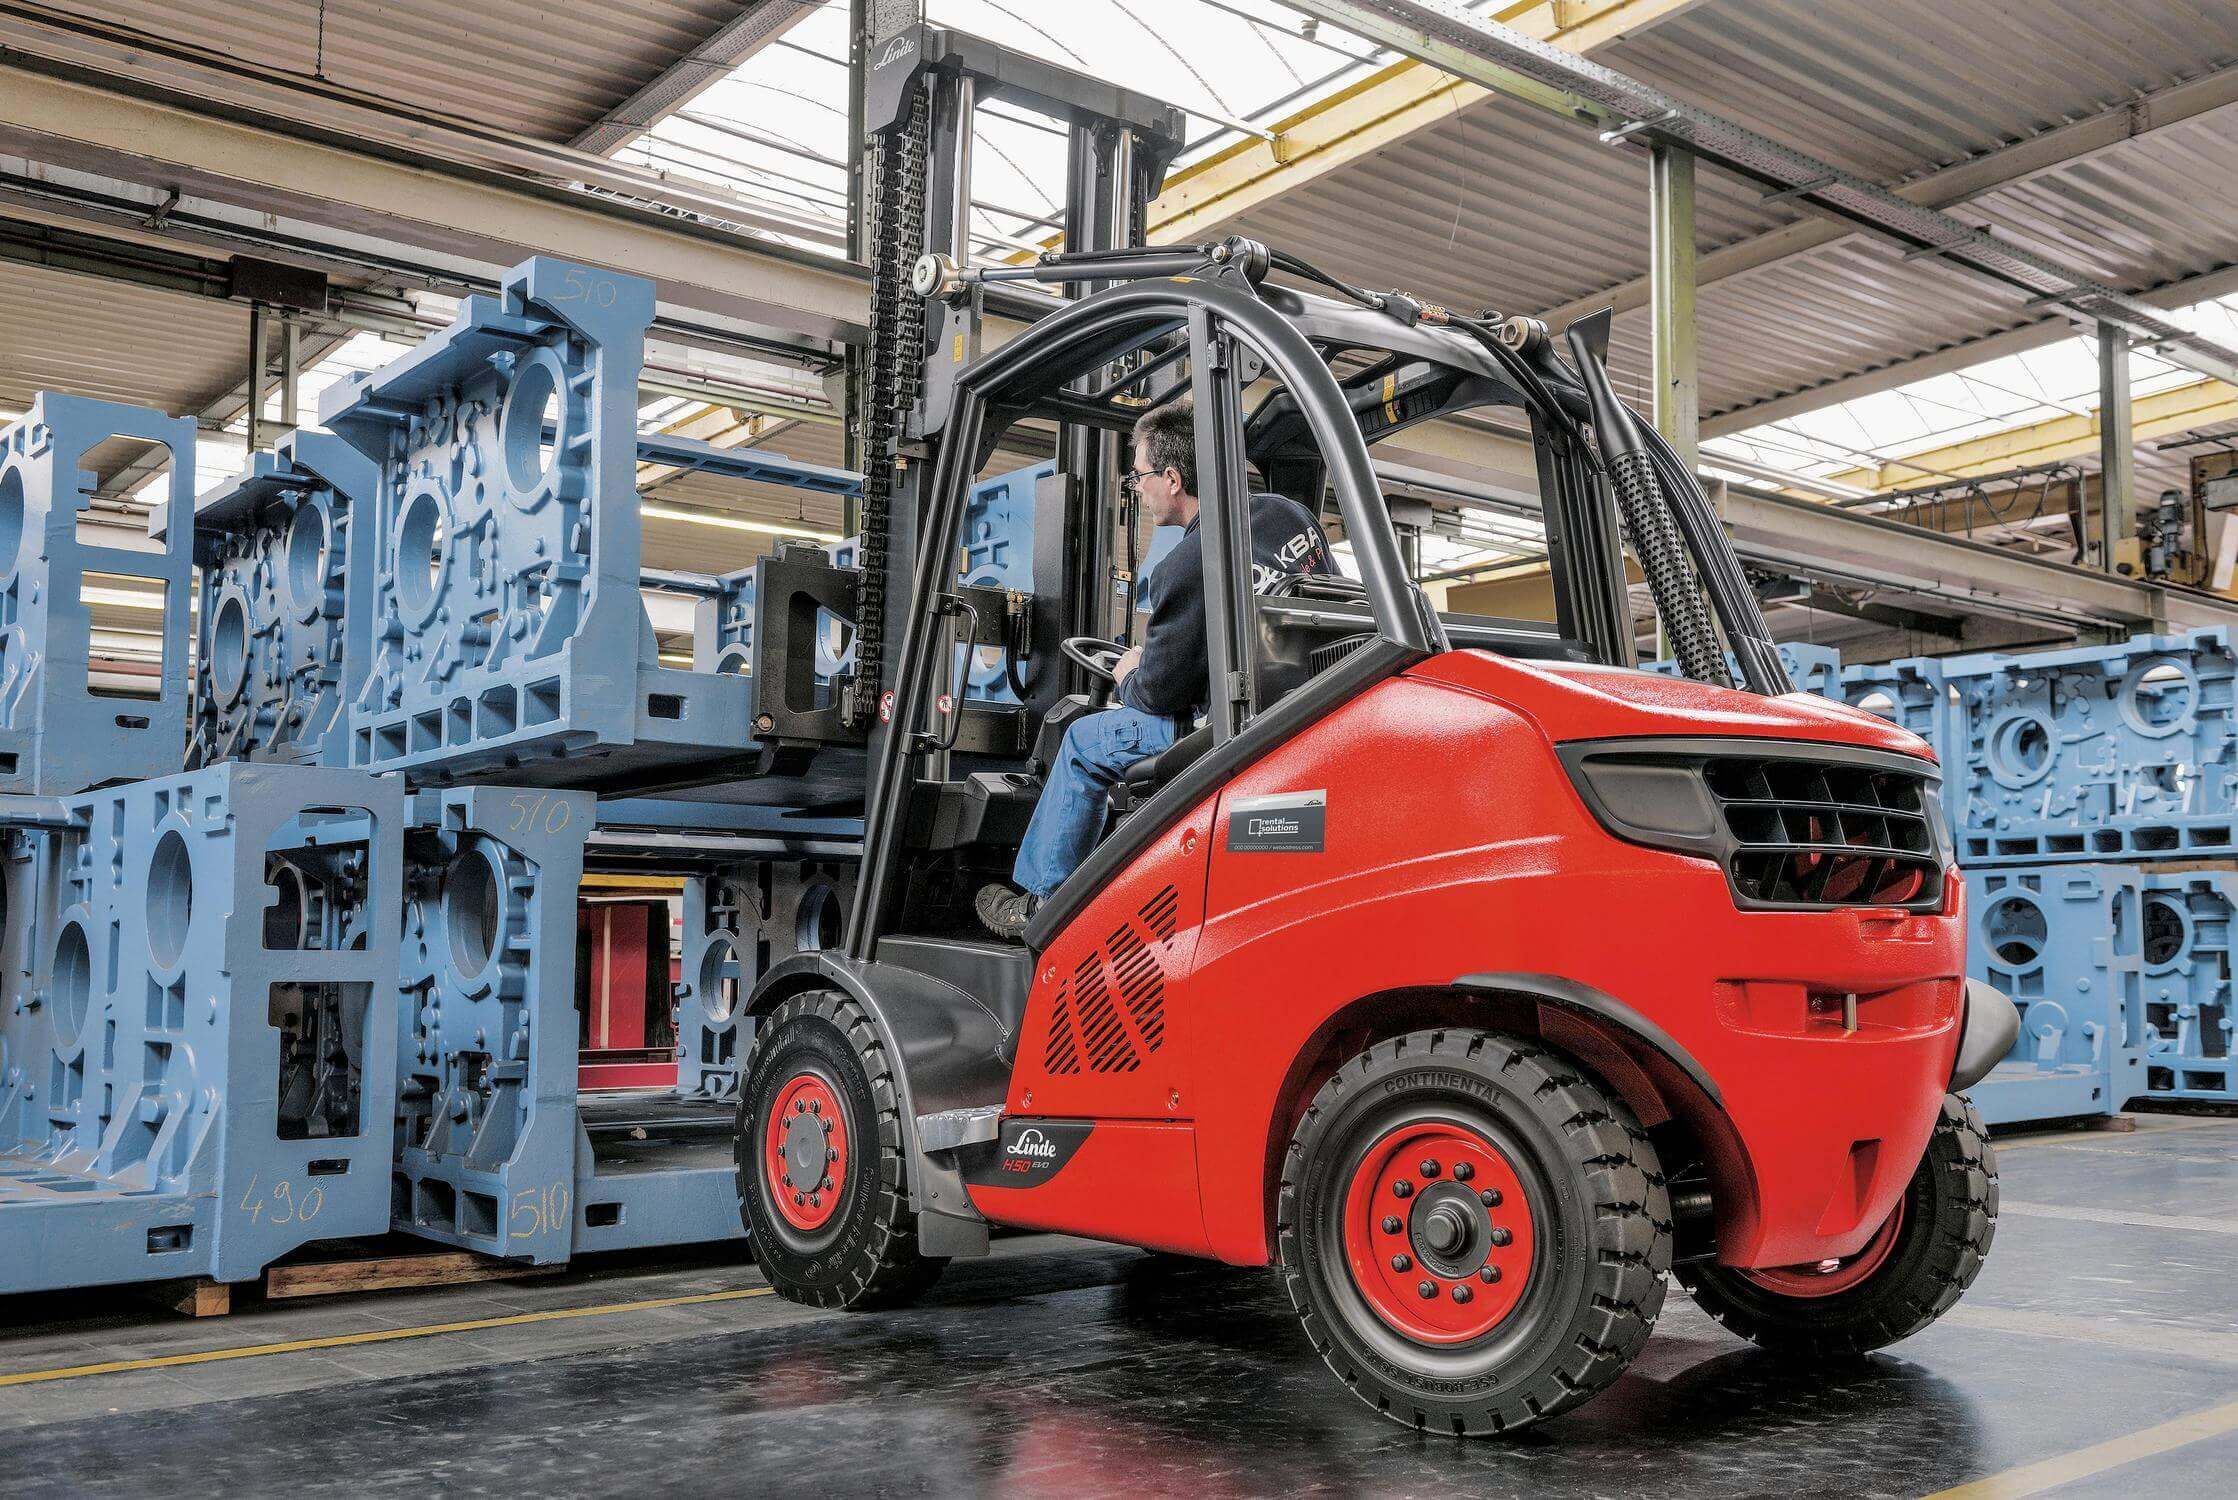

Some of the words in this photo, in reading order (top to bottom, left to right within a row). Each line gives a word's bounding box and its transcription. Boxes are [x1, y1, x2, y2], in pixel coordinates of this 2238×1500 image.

[873, 36, 915, 70] Linde
[552, 268, 617, 308] 510
[510, 794, 570, 833] 510
[1261, 817, 1286, 825] rental
[1261, 824, 1299, 832] solutions
[1384, 1071, 1504, 1106] CONTINENTAL
[1006, 1128, 1057, 1158] Linde
[1002, 1159, 1032, 1173] H50
[240, 1174, 324, 1225] 490
[510, 1182, 569, 1239] 510
